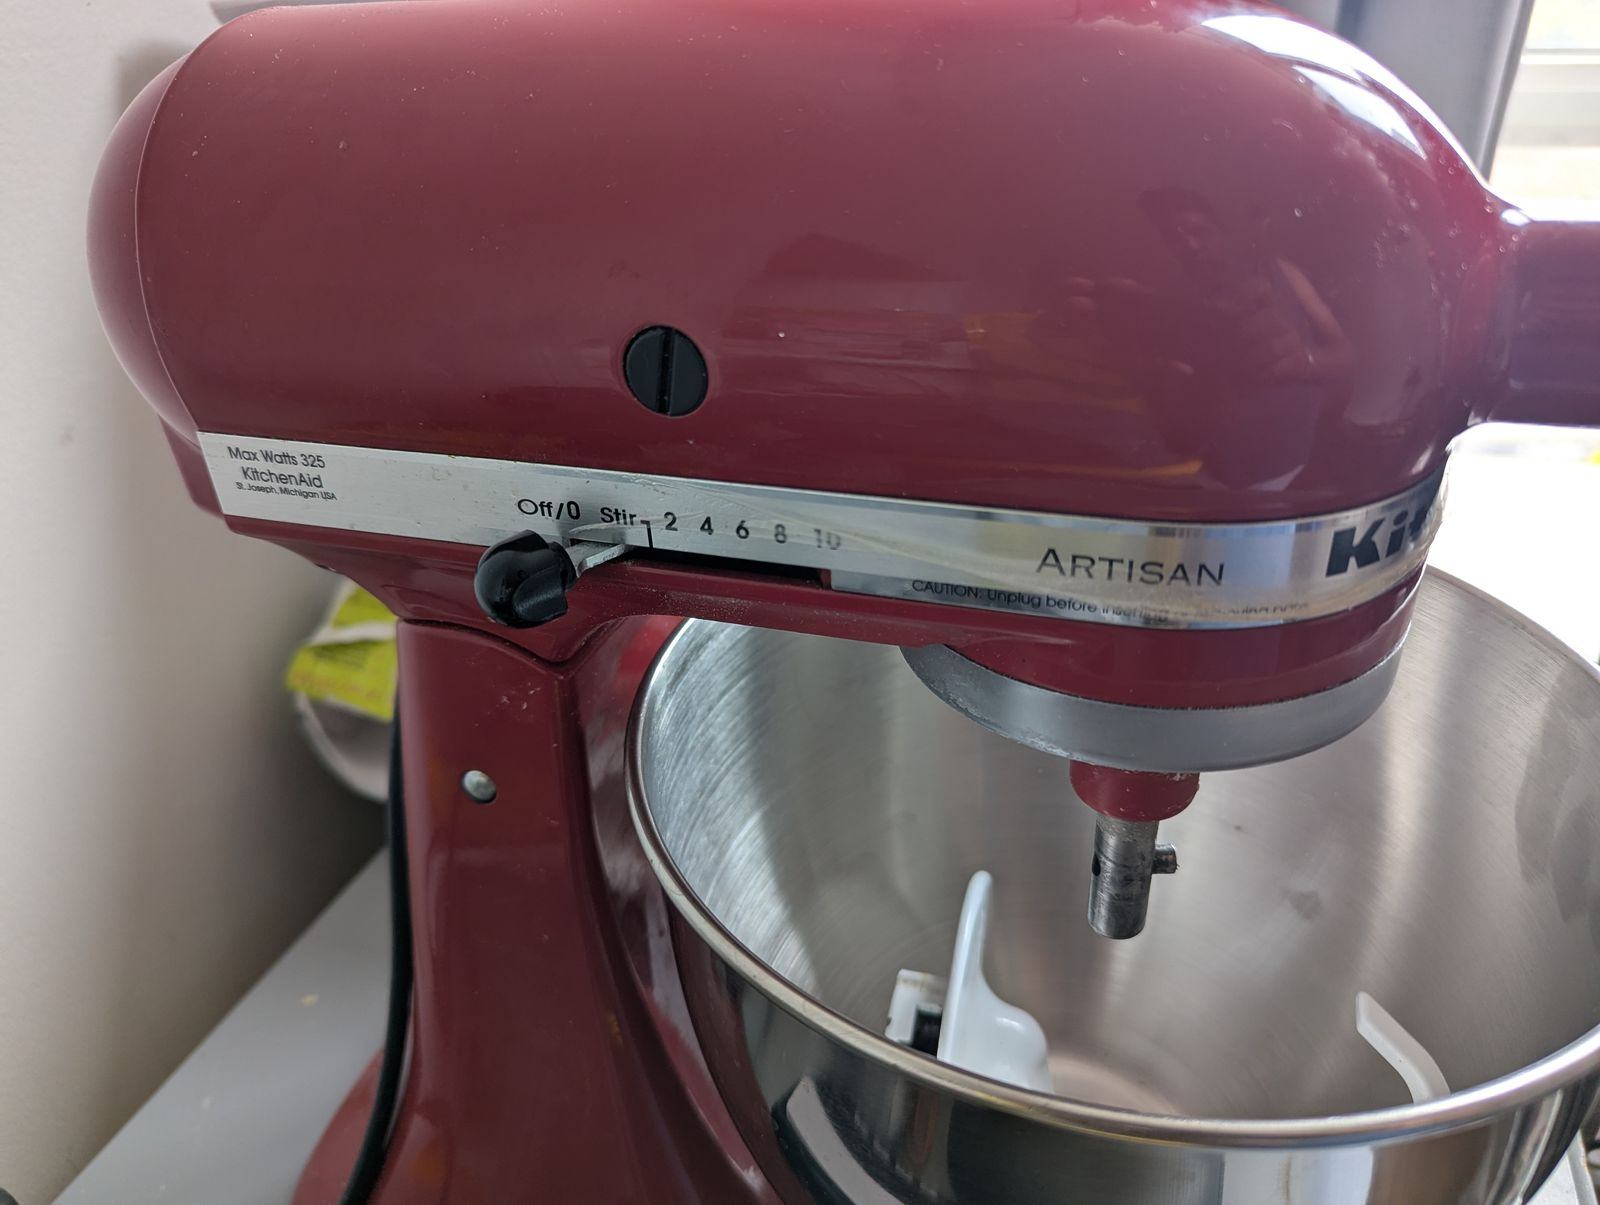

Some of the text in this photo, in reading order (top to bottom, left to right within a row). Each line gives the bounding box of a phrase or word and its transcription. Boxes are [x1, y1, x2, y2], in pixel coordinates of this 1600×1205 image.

[227, 446, 326, 469] Max Watts 325
[241, 466, 324, 489] KitchenAid
[280, 487, 320, 499] Michigan
[320, 491, 338, 501] USA
[518, 498, 842, 551] Off/0 Stir 2 4 6 8 10
[1036, 547, 1225, 587] ARTISAN
[1046, 595, 1098, 612] before
